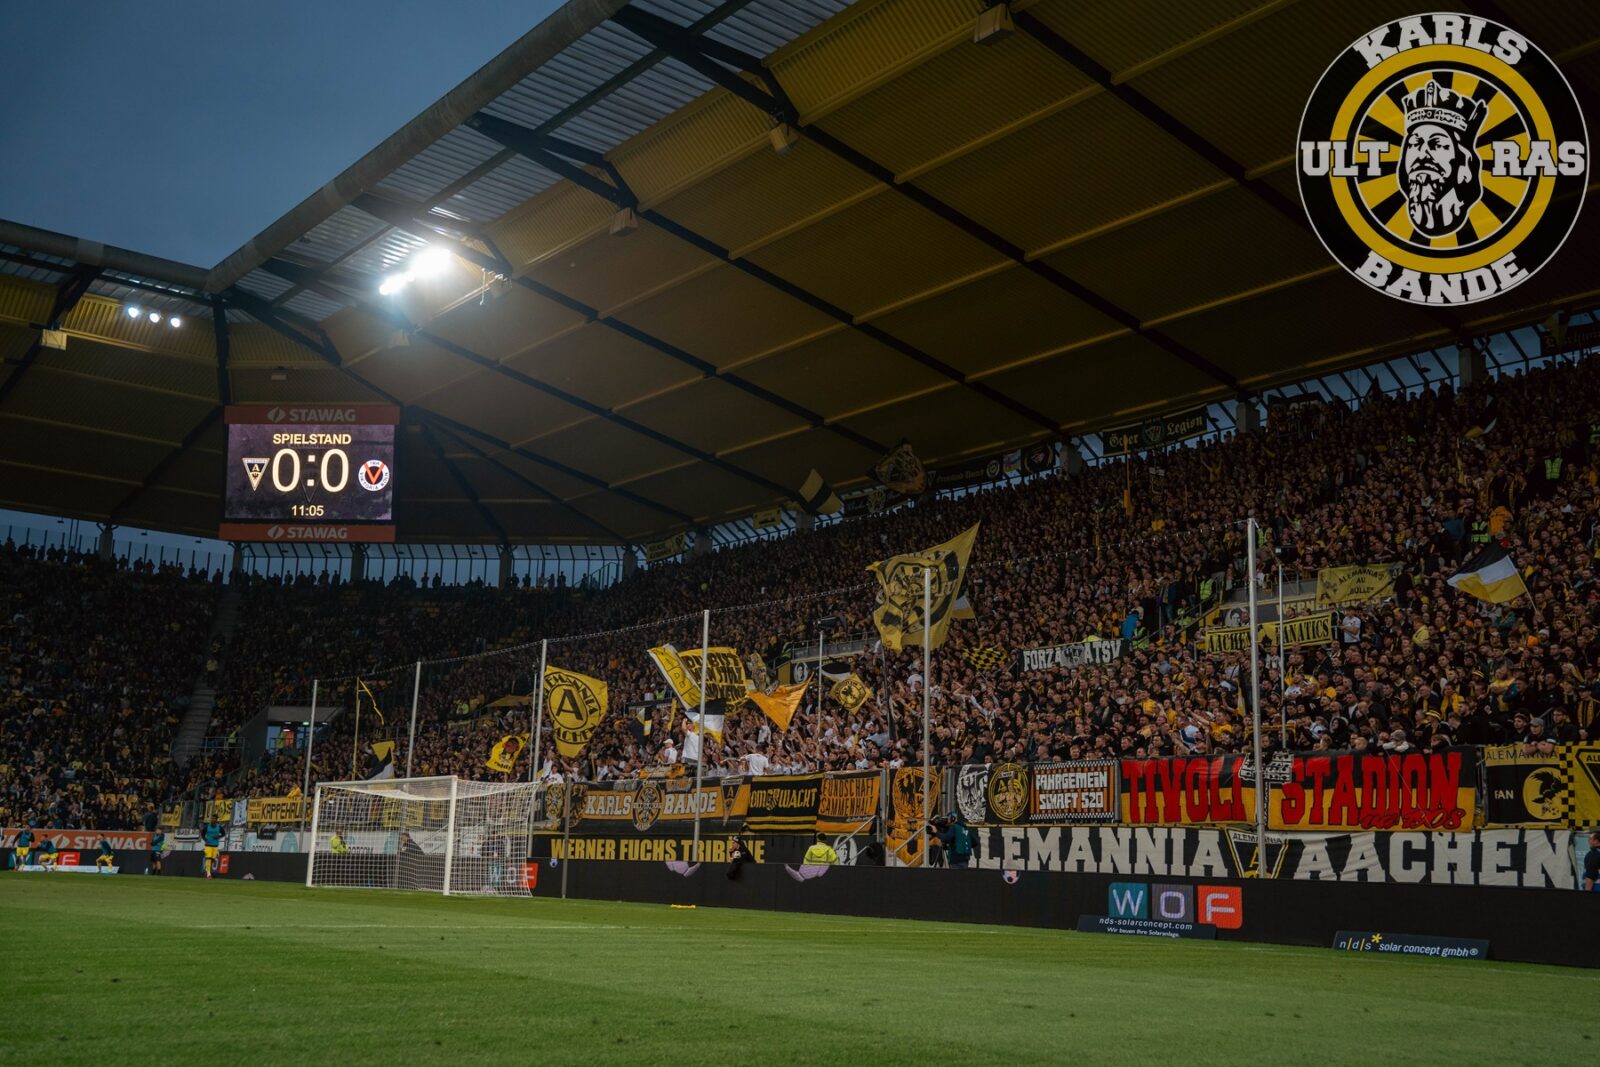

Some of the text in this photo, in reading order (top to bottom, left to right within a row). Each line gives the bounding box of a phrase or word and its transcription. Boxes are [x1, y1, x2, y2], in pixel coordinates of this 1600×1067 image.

[289, 408, 356, 422] STAWAG
[272, 433, 352, 445] SPIELSTAND
[291, 505, 324, 516] 11:05
[287, 527, 348, 539] STAWAG
[1022, 640, 1121, 672] FORZA ATSV
[543, 674, 598, 715] LEMANNIA
[555, 688, 584, 721] A
[1035, 770, 1107, 790] FAHRGEMEIN
[1123, 752, 1463, 825] TIVOLI STADION
[586, 791, 717, 815] KARLS BANDE
[1039, 792, 1079, 809] SCHAFT
[1233, 832, 1282, 845] ALEMNNIA
[550, 838, 616, 860] WERNER
[619, 839, 677, 862] FUCHS
[968, 827, 1228, 877] LEMANNIA
[1293, 829, 1575, 890] AACHEN
[1099, 917, 1193, 930] nds-solarconcept.com
[1379, 941, 1402, 952] solar
[1403, 944, 1440, 955] concept
